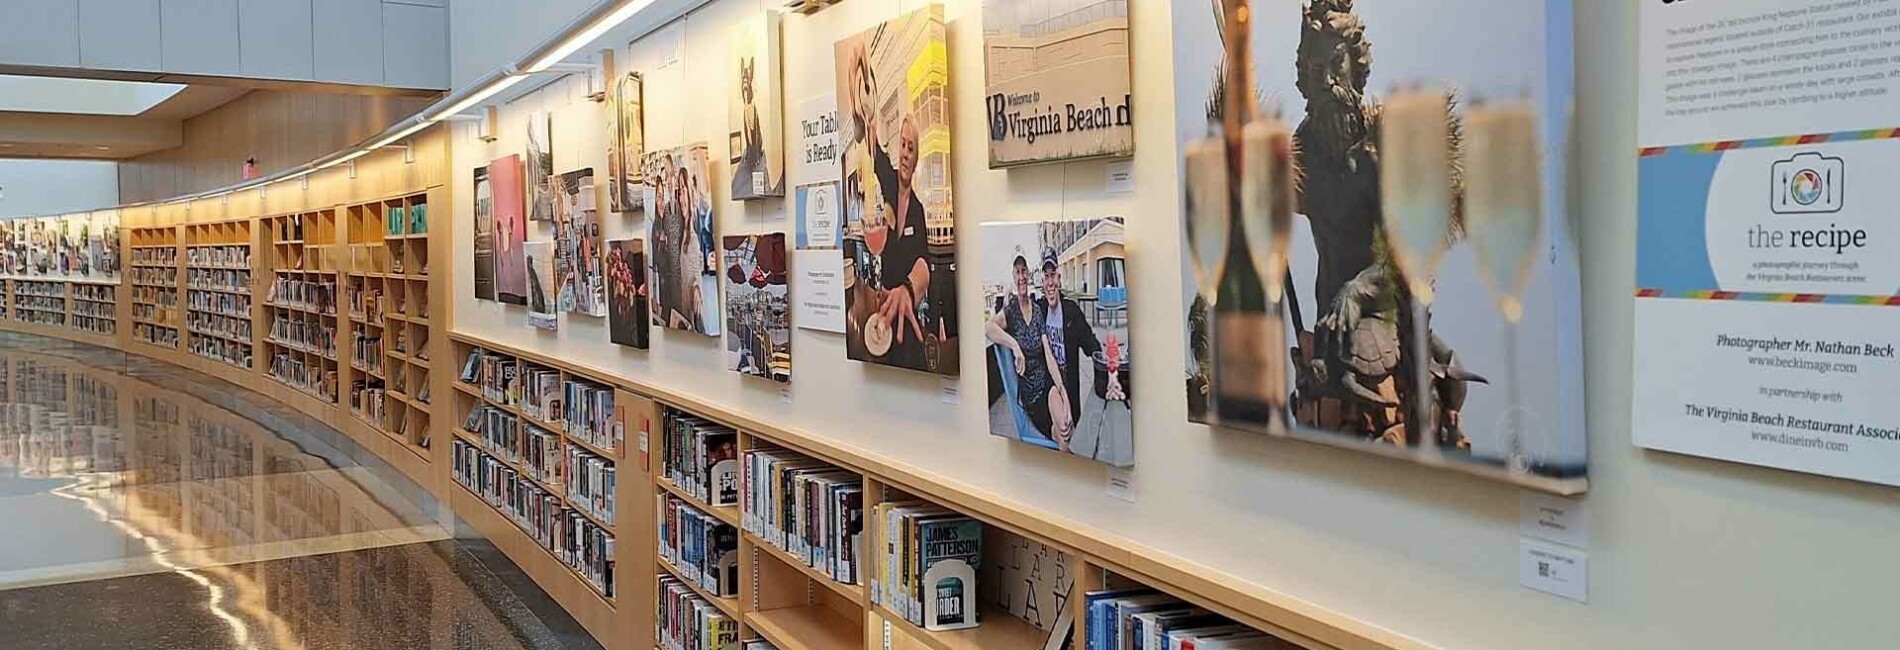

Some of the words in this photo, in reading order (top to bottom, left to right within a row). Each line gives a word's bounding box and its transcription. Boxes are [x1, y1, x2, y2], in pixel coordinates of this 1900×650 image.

[802, 120, 819, 138] Your
[1008, 106, 1062, 144] Virginia
[1066, 96, 1112, 132] Beach
[806, 144, 812, 164] is
[813, 138, 837, 166] Ready
[1747, 224, 1784, 248] the
[1790, 223, 1867, 254] recipe
[1716, 334, 1793, 351] Photographer
[1795, 339, 1812, 352] Mr.
[1815, 341, 1861, 356] Nathan
[1864, 344, 1895, 358] Beck
[1748, 356, 1858, 373] www.beckimage.com
[1759, 386, 1768, 394] in
[1768, 386, 1820, 402] partnership
[1822, 391, 1843, 402] with
[1685, 404, 1704, 416] The
[1706, 407, 1748, 423] Virginia
[1751, 412, 1784, 427] Beach
[1786, 416, 1854, 435] Restaurant
[1751, 431, 1848, 452] www.dineinvb.com
[926, 526, 959, 542] JAMES
[926, 538, 979, 558] PATTERSON
